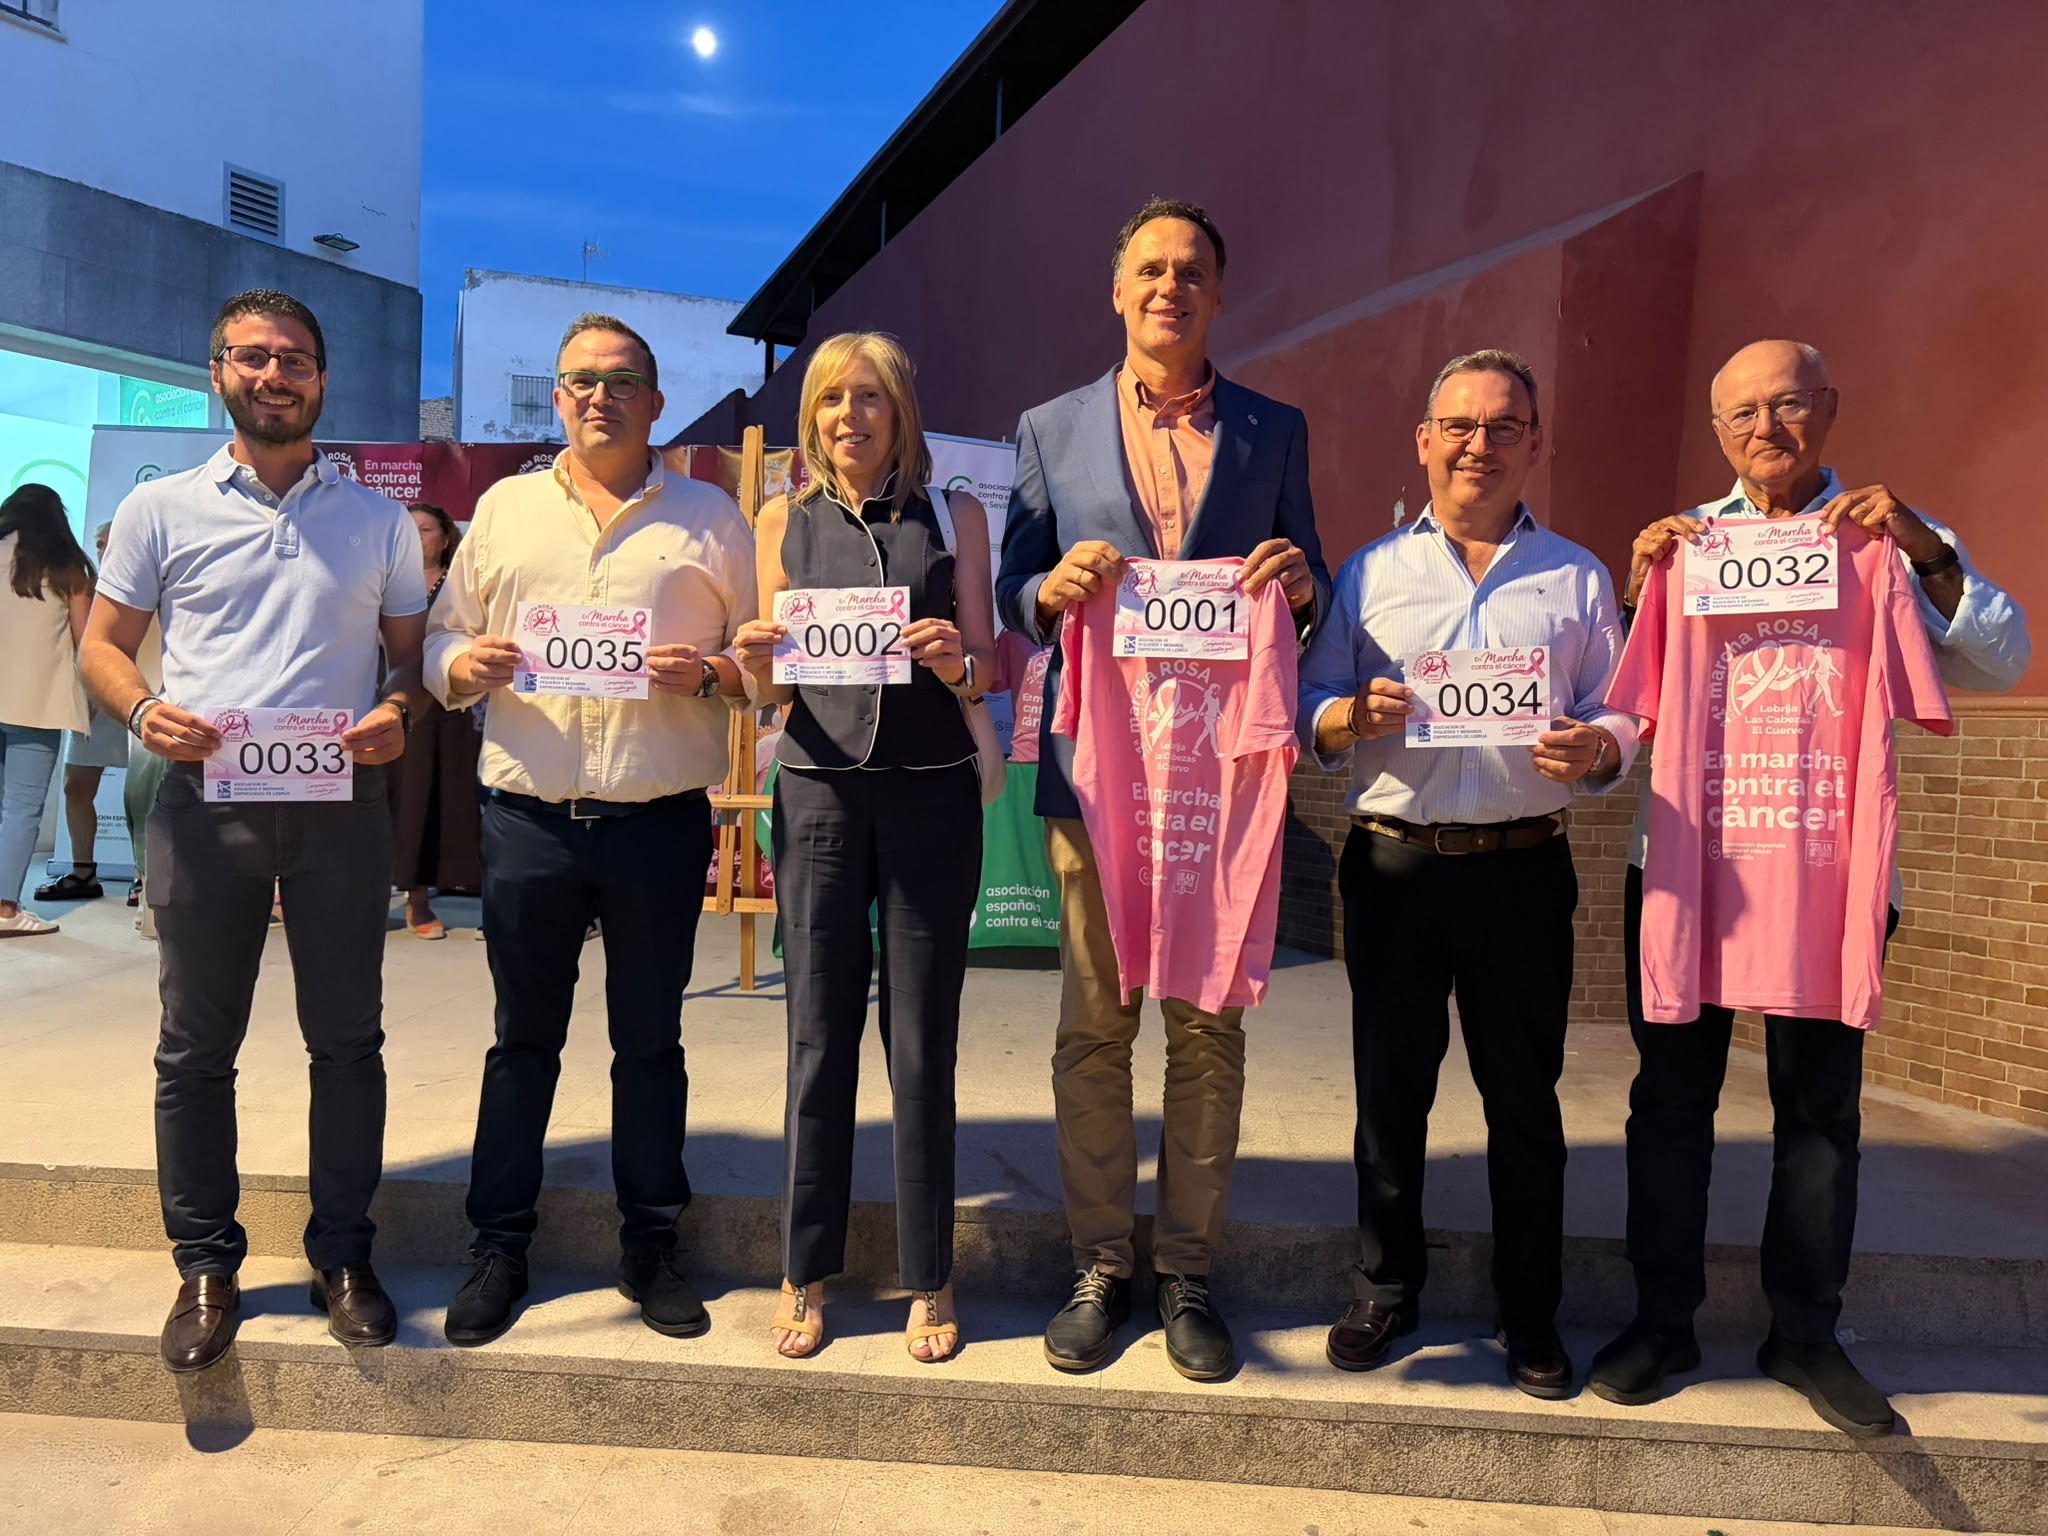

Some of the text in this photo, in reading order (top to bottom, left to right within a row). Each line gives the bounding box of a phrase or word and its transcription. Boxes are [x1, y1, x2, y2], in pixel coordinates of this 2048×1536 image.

[327, 452, 352, 463] ROSA
[533, 453, 554, 464] ROS
[364, 459, 423, 471] En marcha
[364, 472, 422, 484] contra el
[978, 482, 1012, 492] asociaci
[977, 491, 1004, 500] contra
[989, 501, 1009, 510] Sevill
[1768, 522, 1813, 539] Marcha
[1754, 538, 1778, 546] contra
[1787, 535, 1813, 543] cáncer
[1189, 567, 1229, 581] Marcha
[1719, 553, 1830, 590] 0032
[1207, 579, 1230, 587] cáncer
[847, 590, 888, 605] Marcha
[858, 603, 865, 611] el
[865, 603, 888, 611] cáncer
[590, 609, 629, 622] Marcha
[1145, 598, 1236, 633] 0001
[578, 620, 600, 628] contra
[608, 620, 630, 629] cáncer
[805, 622, 903, 658] 0002
[546, 636, 643, 673] 0035
[1482, 648, 1526, 664] Marcha
[1710, 632, 1753, 699] marcha
[1756, 618, 1819, 640] ROSA
[1471, 661, 1527, 670] contra el cáncer
[1128, 671, 1158, 734] marcha
[1160, 659, 1211, 684] ROSA
[1438, 681, 1543, 717] 0034
[1759, 704, 1798, 714] Lebrija
[286, 711, 329, 725] Marcha
[1744, 716, 1812, 724] Las Cabezas
[298, 723, 306, 731] el
[306, 722, 331, 731] cáncer
[1752, 726, 1804, 735] El Cuervo
[239, 742, 346, 775] 0033
[1704, 749, 1848, 771] En marcha
[1705, 773, 1847, 799] contra el
[1706, 797, 1846, 831] cáncer
[1190, 812, 1216, 835] el
[985, 883, 1050, 899] asociación
[985, 915, 1029, 928] contra
[1031, 916, 1042, 928] el
